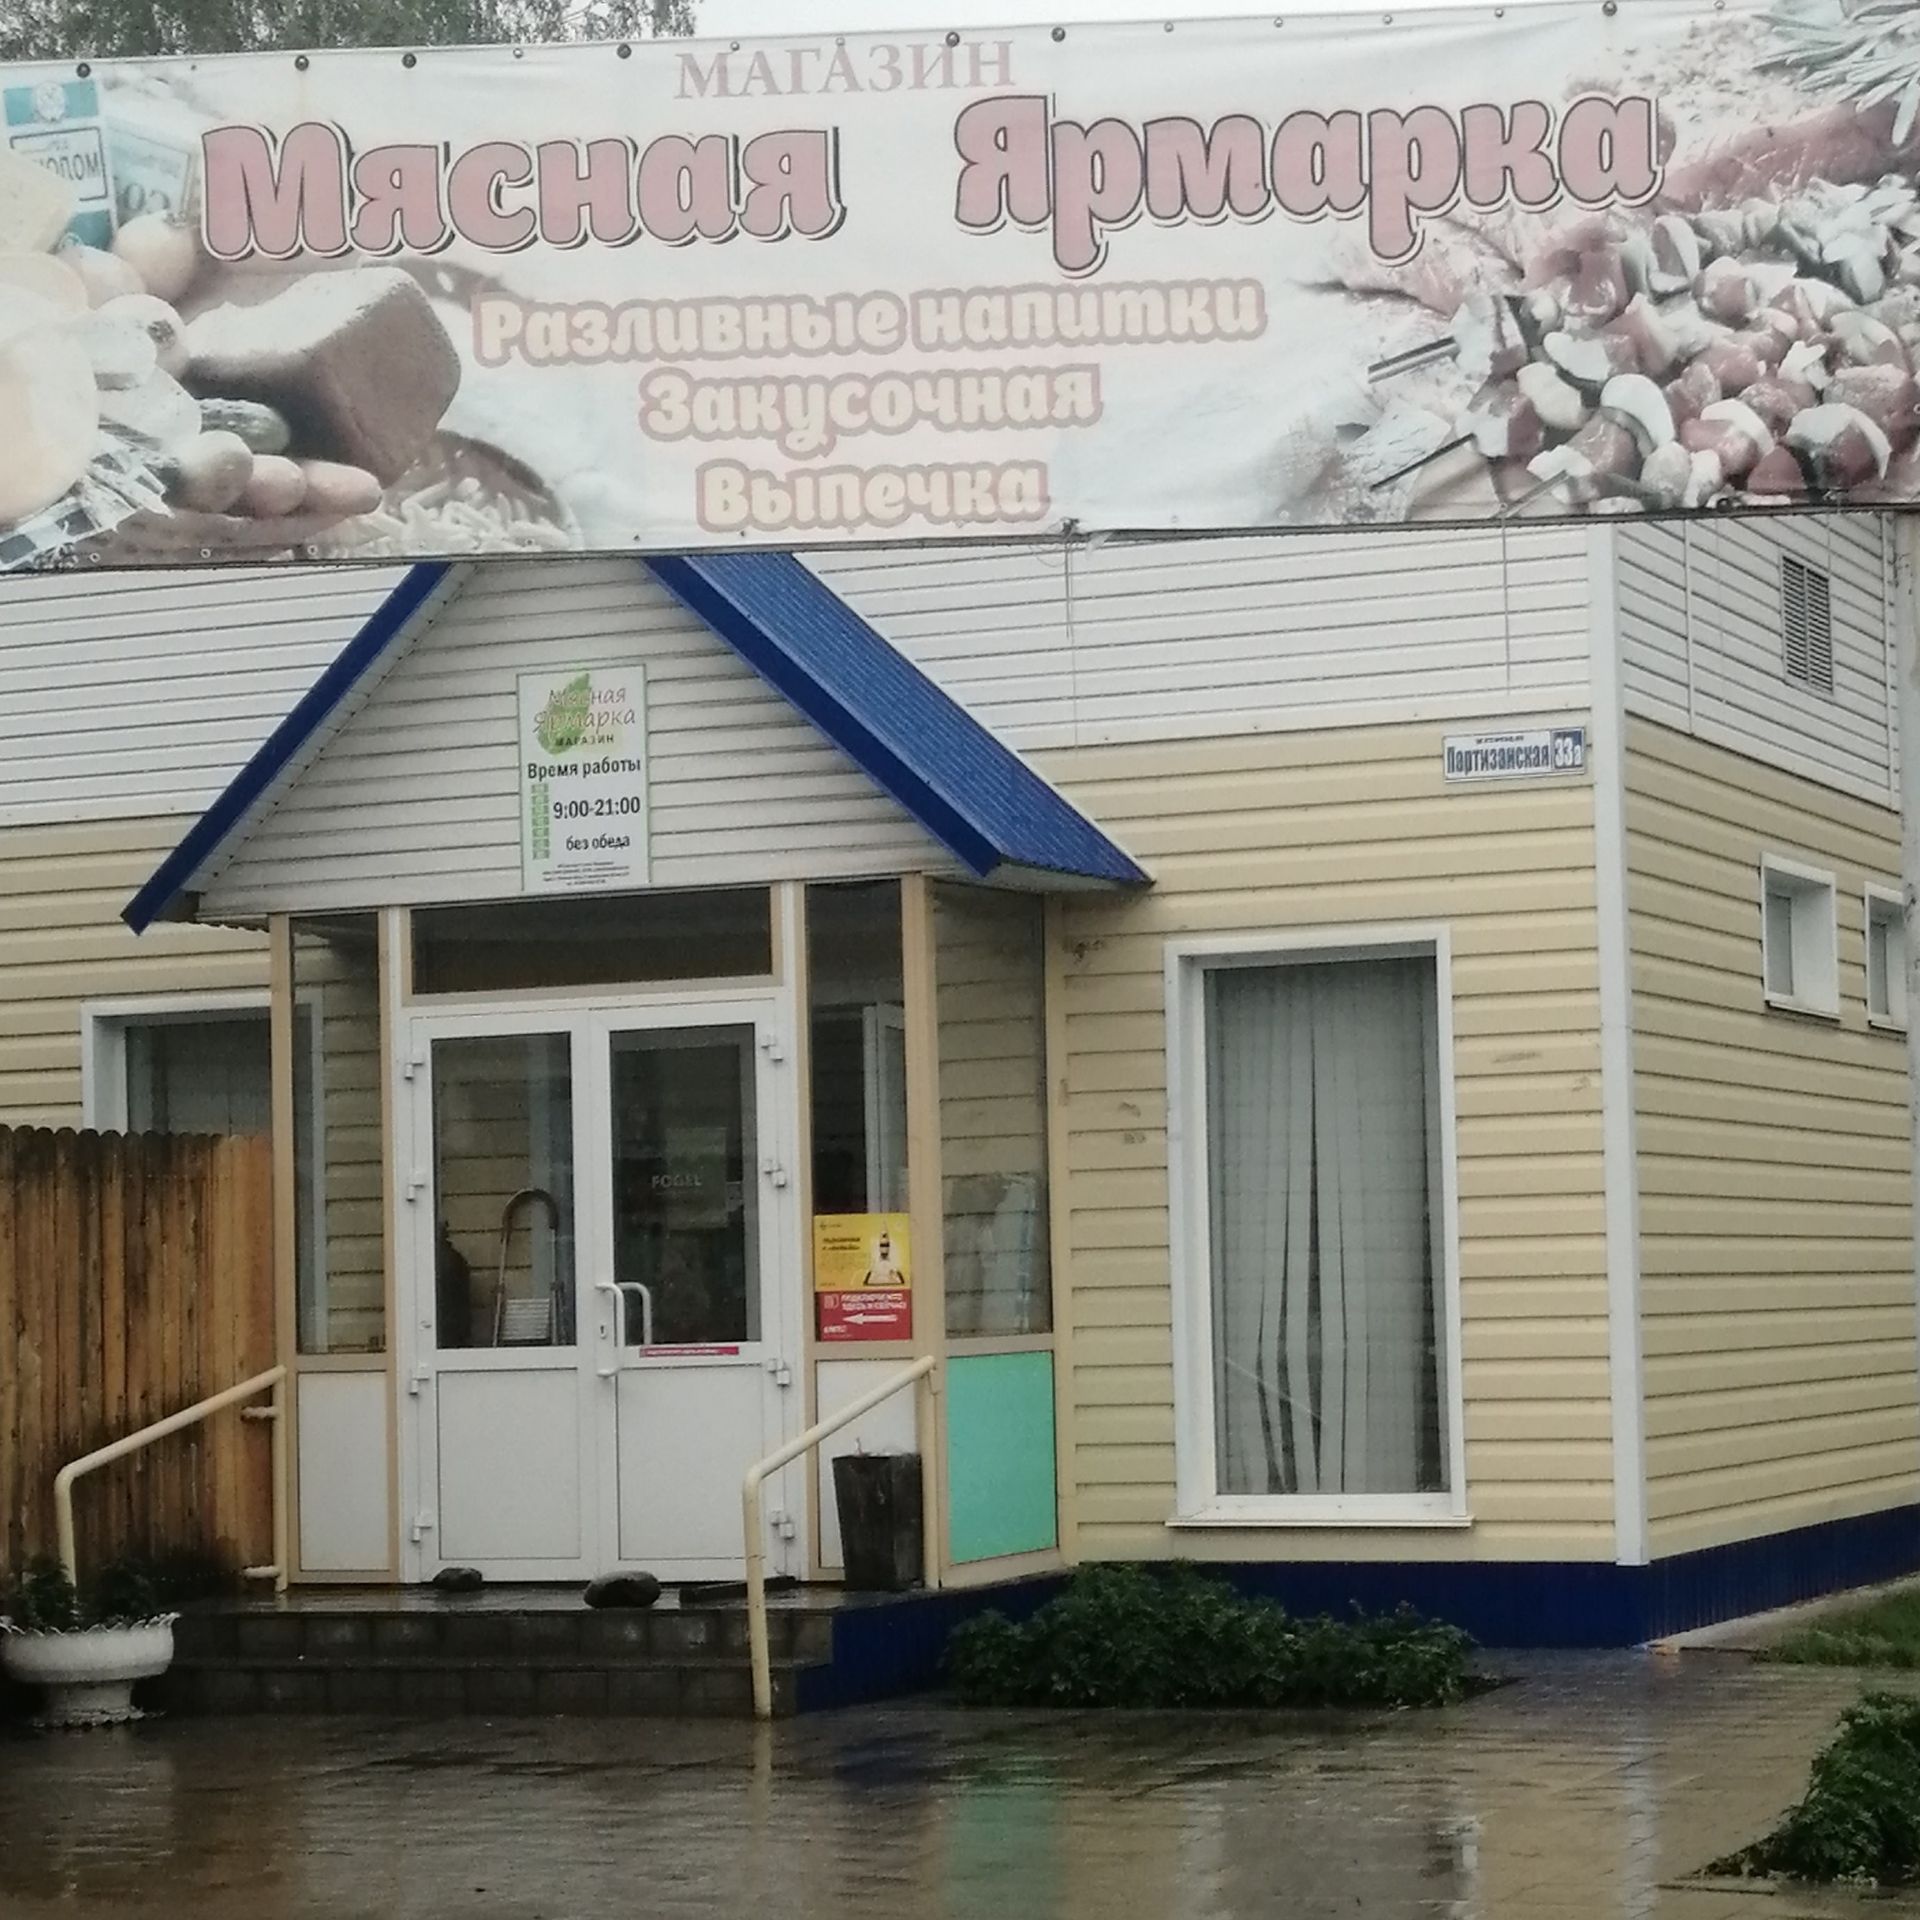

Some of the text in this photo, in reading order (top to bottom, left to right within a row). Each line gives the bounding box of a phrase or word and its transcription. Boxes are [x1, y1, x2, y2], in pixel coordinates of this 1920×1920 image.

[674, 39, 1018, 99] МАГАЗИН
[201, 92, 1665, 278] Мясная Ярмарка
[470, 279, 1268, 368] Разливные напитки
[638, 363, 1103, 459] Закусочная
[695, 459, 1052, 534] Выпечка
[527, 756, 641, 781] Время работы
[1446, 744, 1550, 776] Партизанская
[552, 796, 641, 820] 9:00-21:00
[565, 833, 631, 851] без обеда
